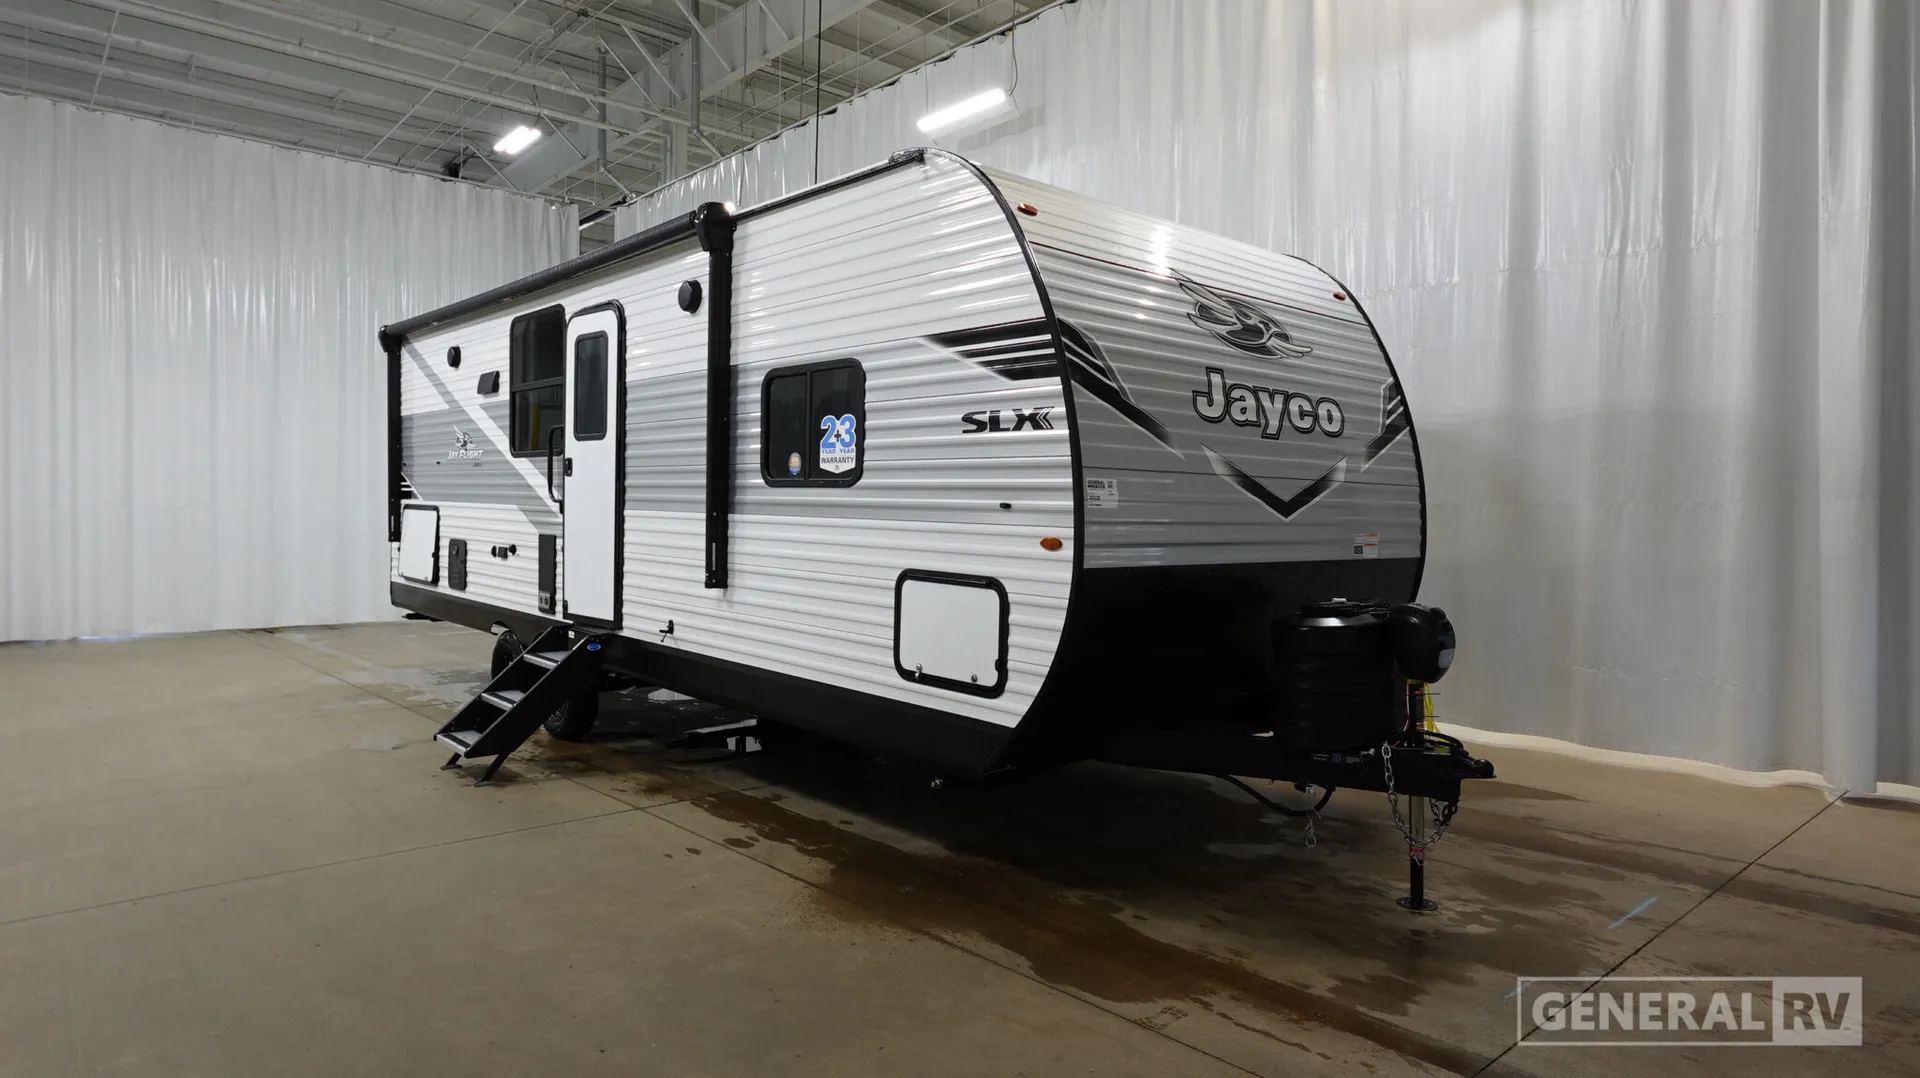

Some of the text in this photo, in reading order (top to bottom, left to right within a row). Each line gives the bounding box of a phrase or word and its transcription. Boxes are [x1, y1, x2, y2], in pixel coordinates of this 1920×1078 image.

[1192, 366, 1345, 440] Jayco
[961, 406, 1055, 434] SLX
[821, 456, 854, 464] WARRANTY
